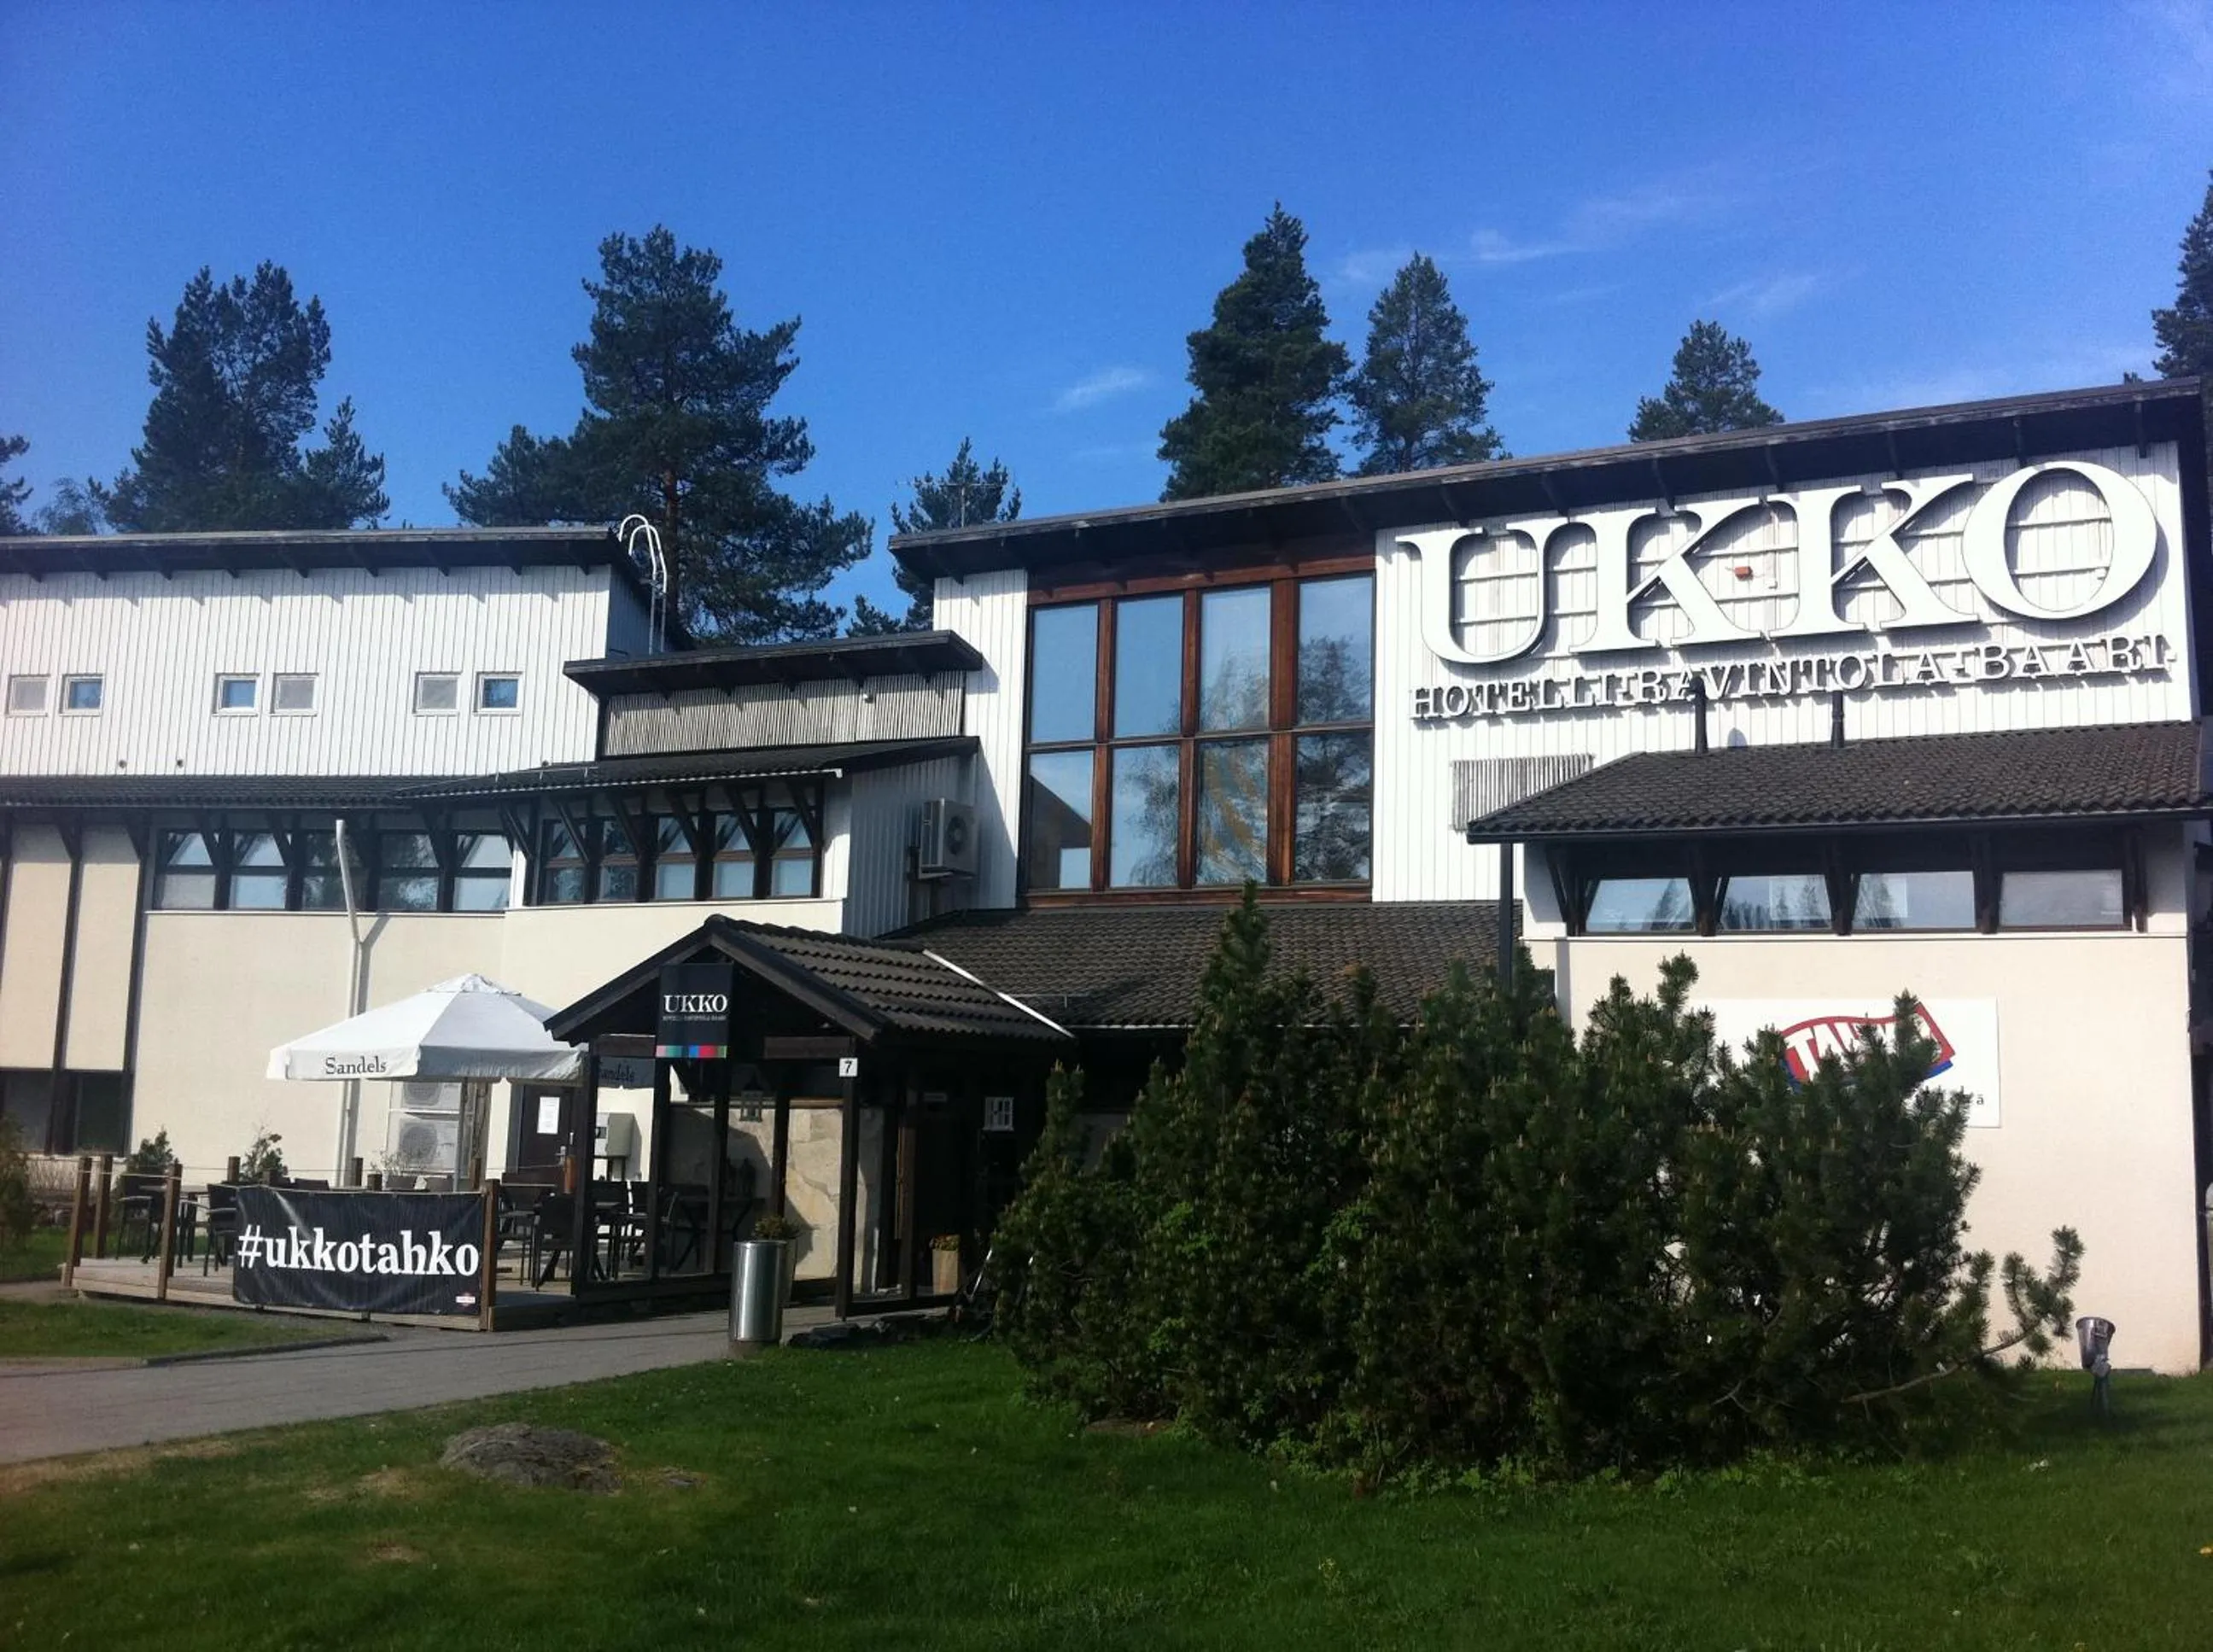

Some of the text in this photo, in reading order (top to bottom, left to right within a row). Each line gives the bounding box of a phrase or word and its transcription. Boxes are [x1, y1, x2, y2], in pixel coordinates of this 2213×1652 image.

[1396, 460, 2158, 664] UKKO
[663, 994, 727, 1013] UKKO
[325, 1055, 388, 1075] Sandels
[844, 1060, 852, 1074] 7
[238, 1224, 479, 1276] #ukkotahko
